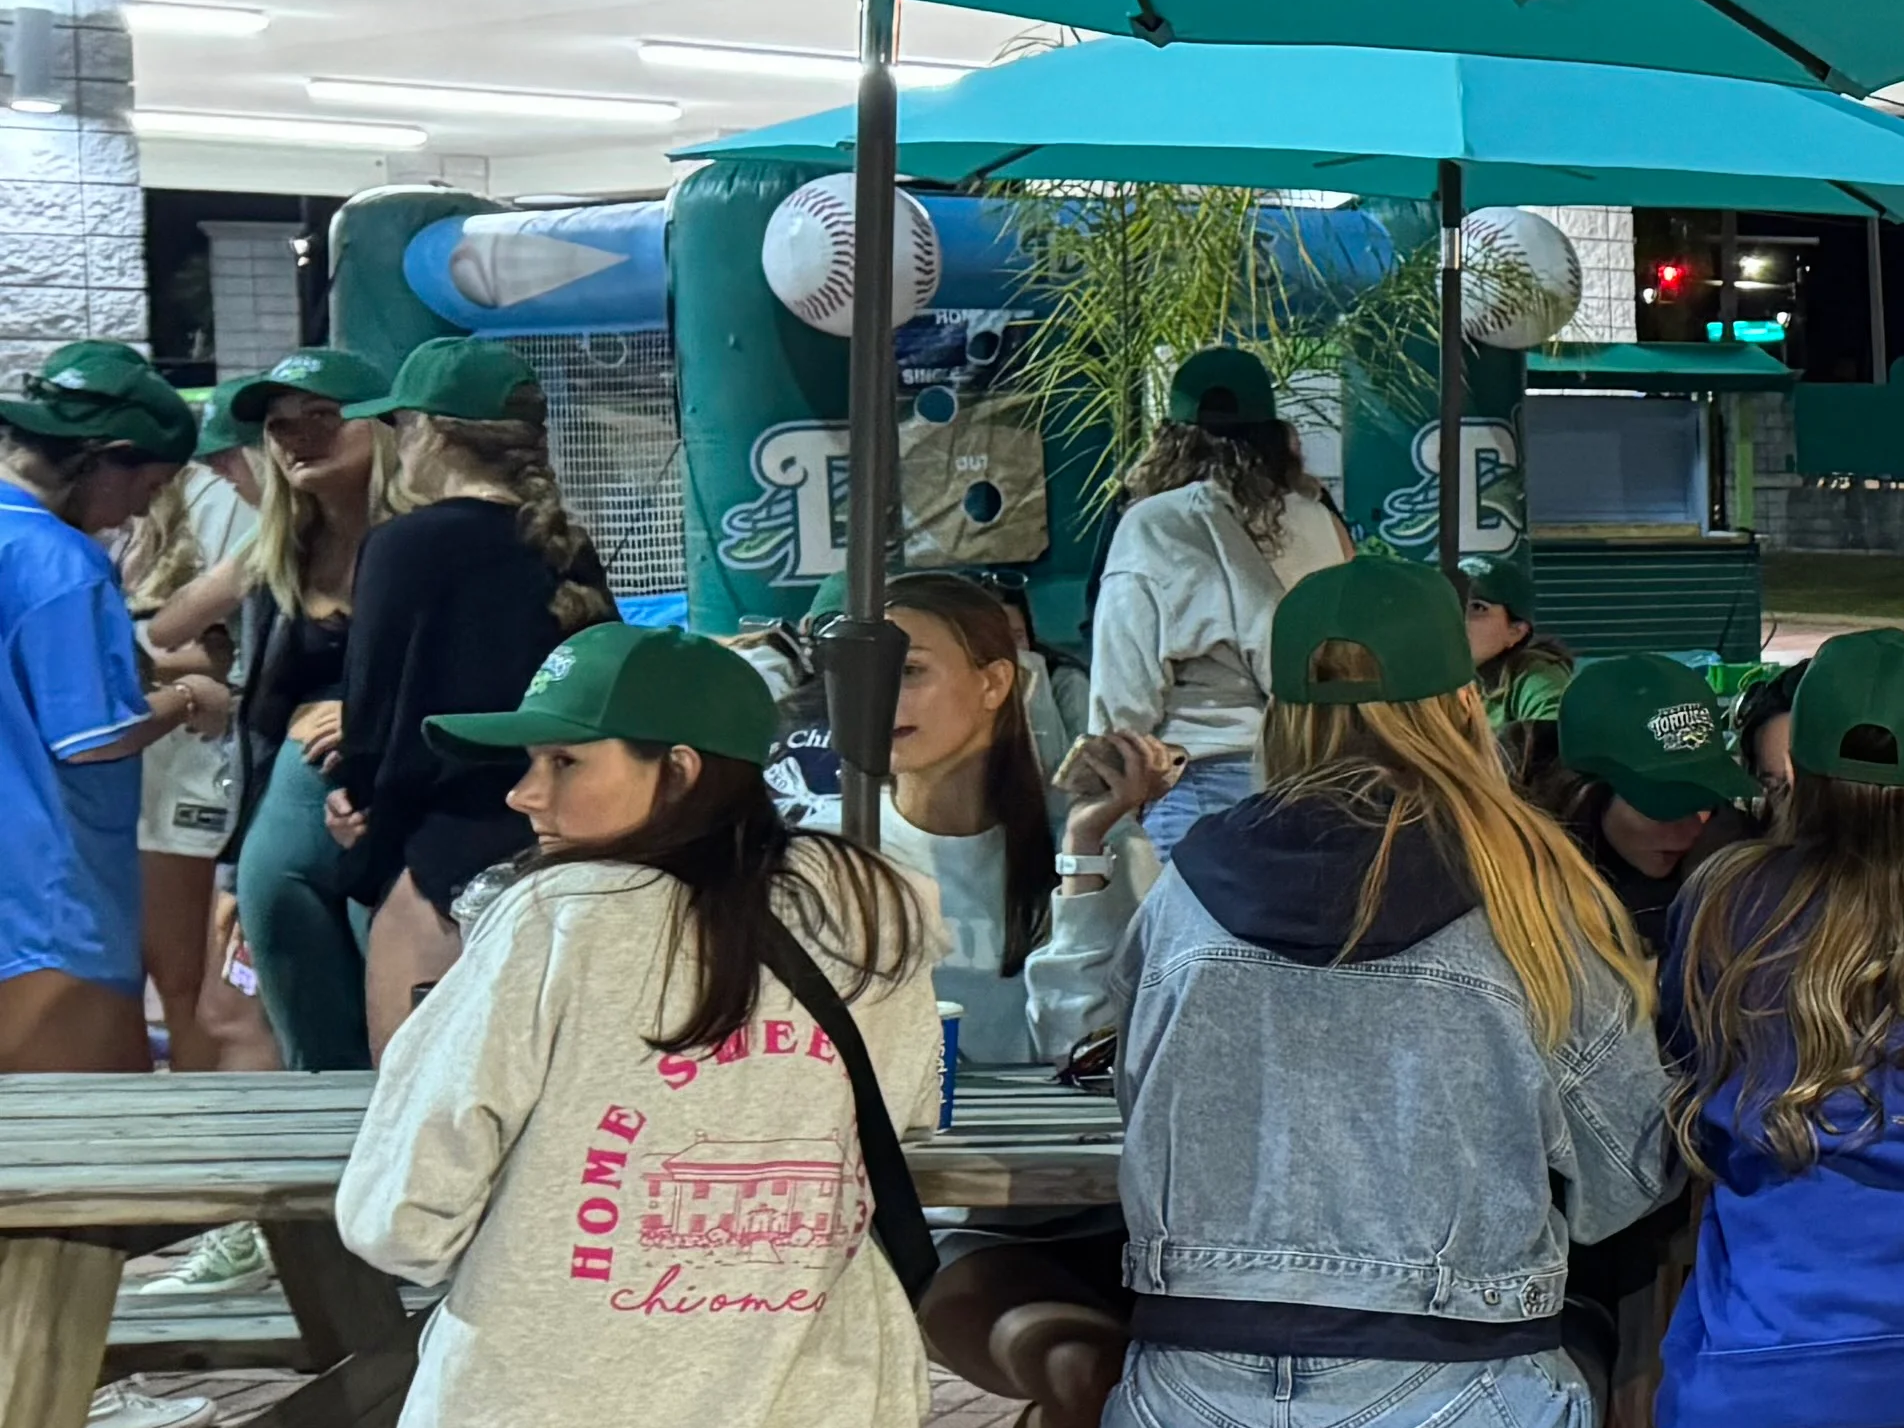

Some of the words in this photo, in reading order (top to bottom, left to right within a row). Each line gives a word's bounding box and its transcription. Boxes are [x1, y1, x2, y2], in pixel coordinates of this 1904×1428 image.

[955, 453, 988, 472] OUT
[570, 1103, 648, 1283] HOME
[656, 1018, 854, 1091] SWEE
